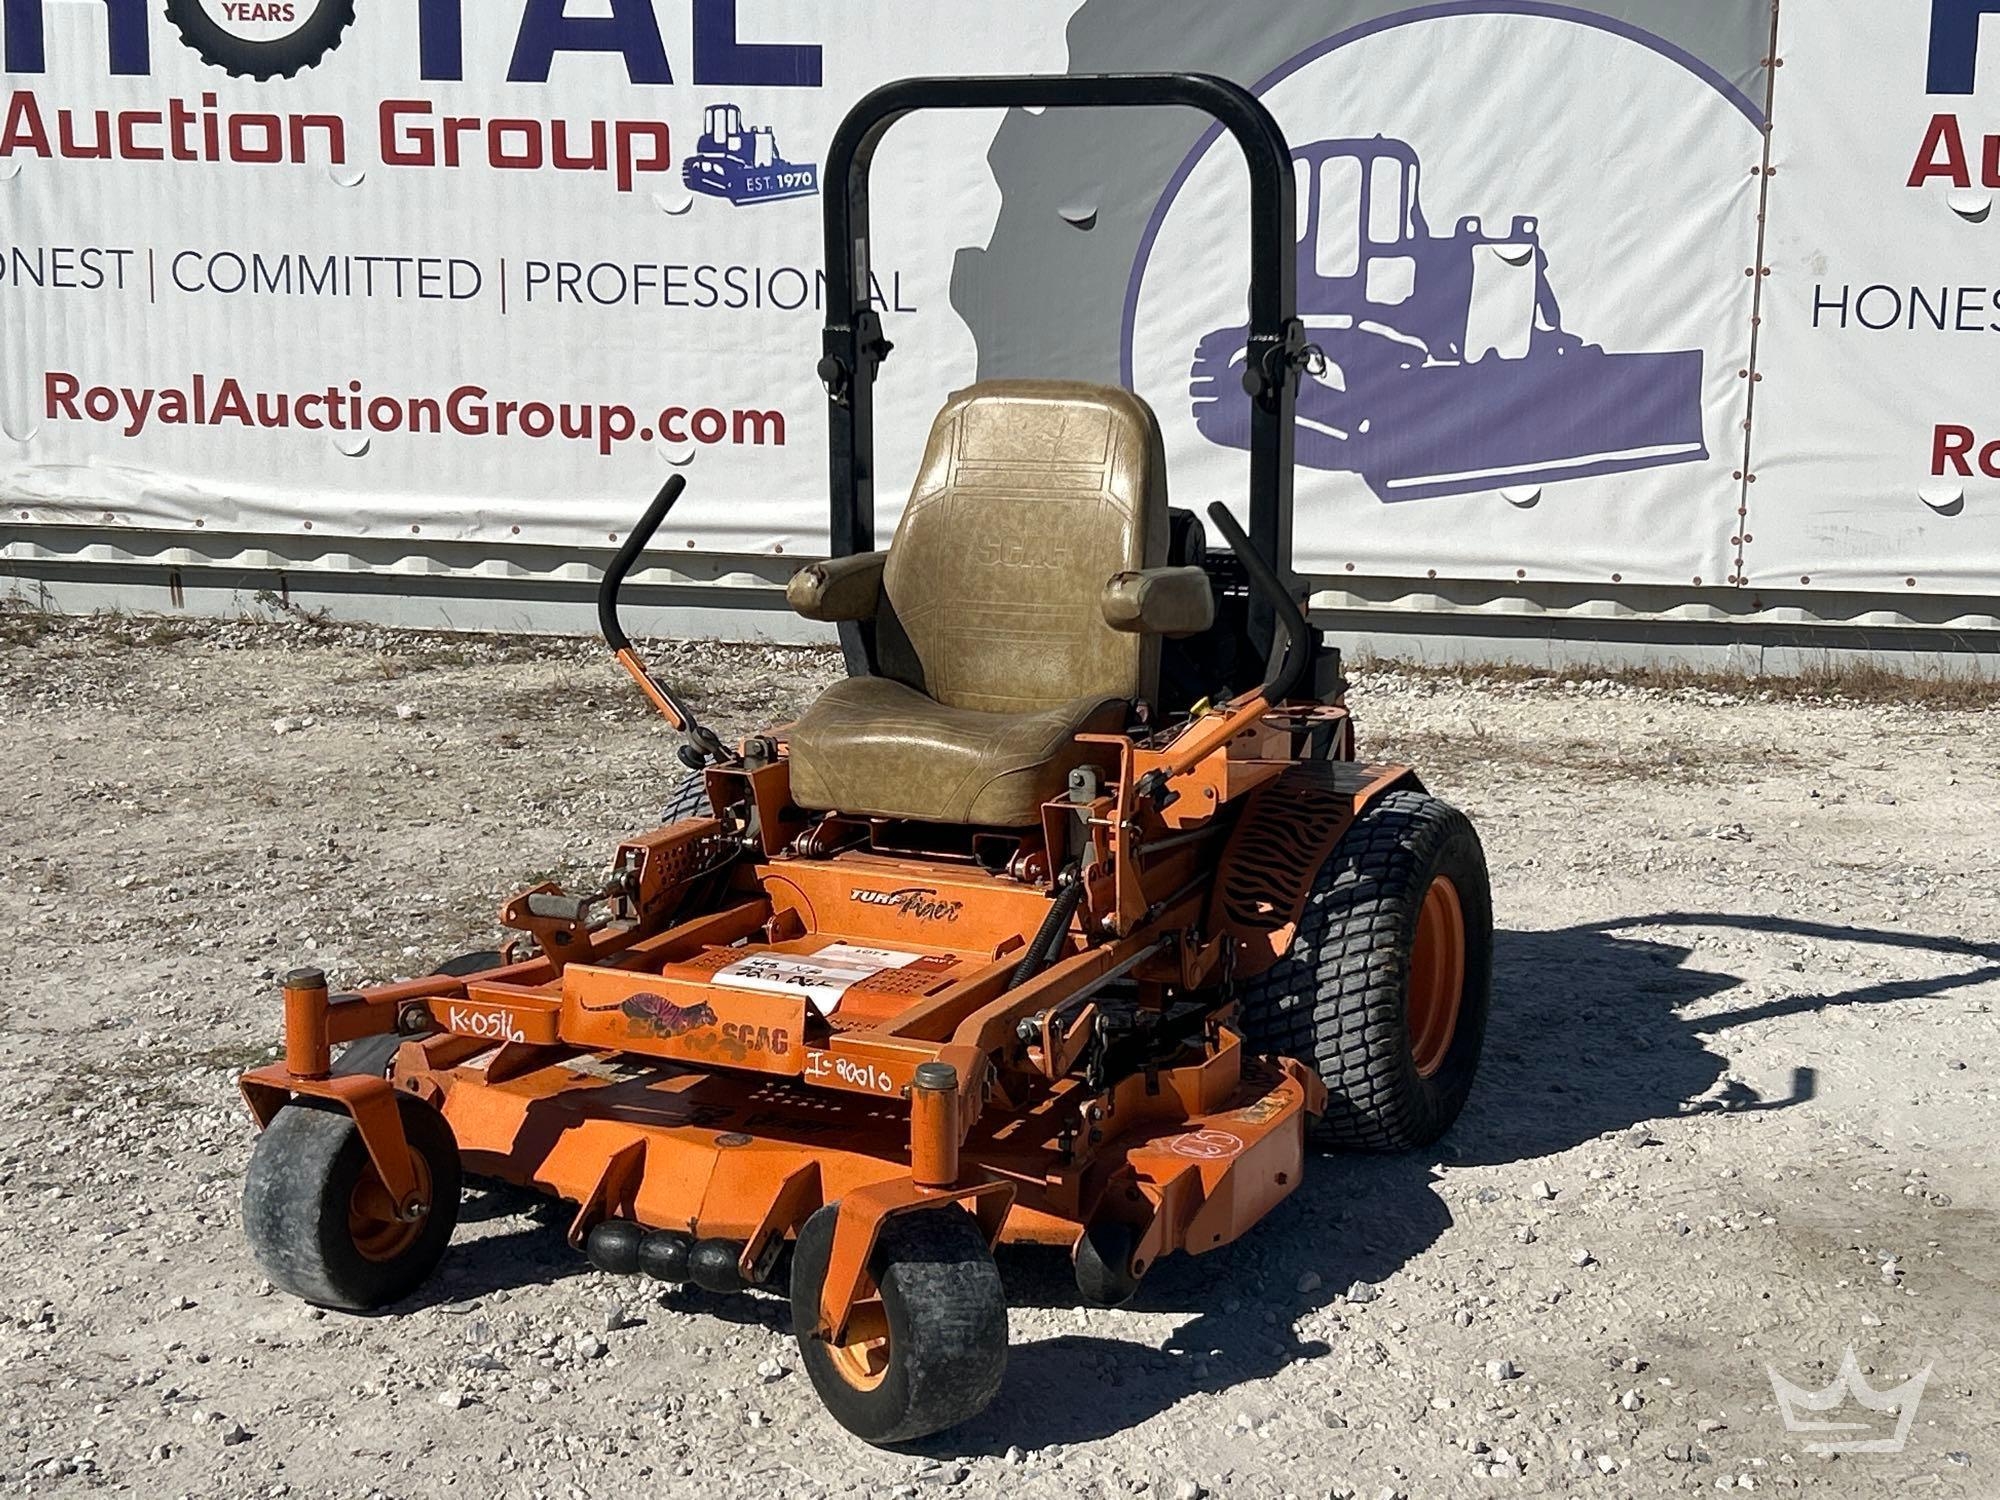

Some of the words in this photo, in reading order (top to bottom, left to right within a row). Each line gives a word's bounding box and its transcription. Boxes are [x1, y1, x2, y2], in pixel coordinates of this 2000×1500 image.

[221, 2, 295, 22] YEARS
[0, 91, 346, 164] Auction
[379, 99, 671, 192] Group
[746, 177, 773, 191] EST.
[776, 172, 812, 189] 1970
[0, 246, 134, 290] NEST
[172, 250, 482, 300] COMMITTED
[45, 371, 786, 456] RoyalAuctionGroup.com
[722, 1022, 789, 1055] SCAG
